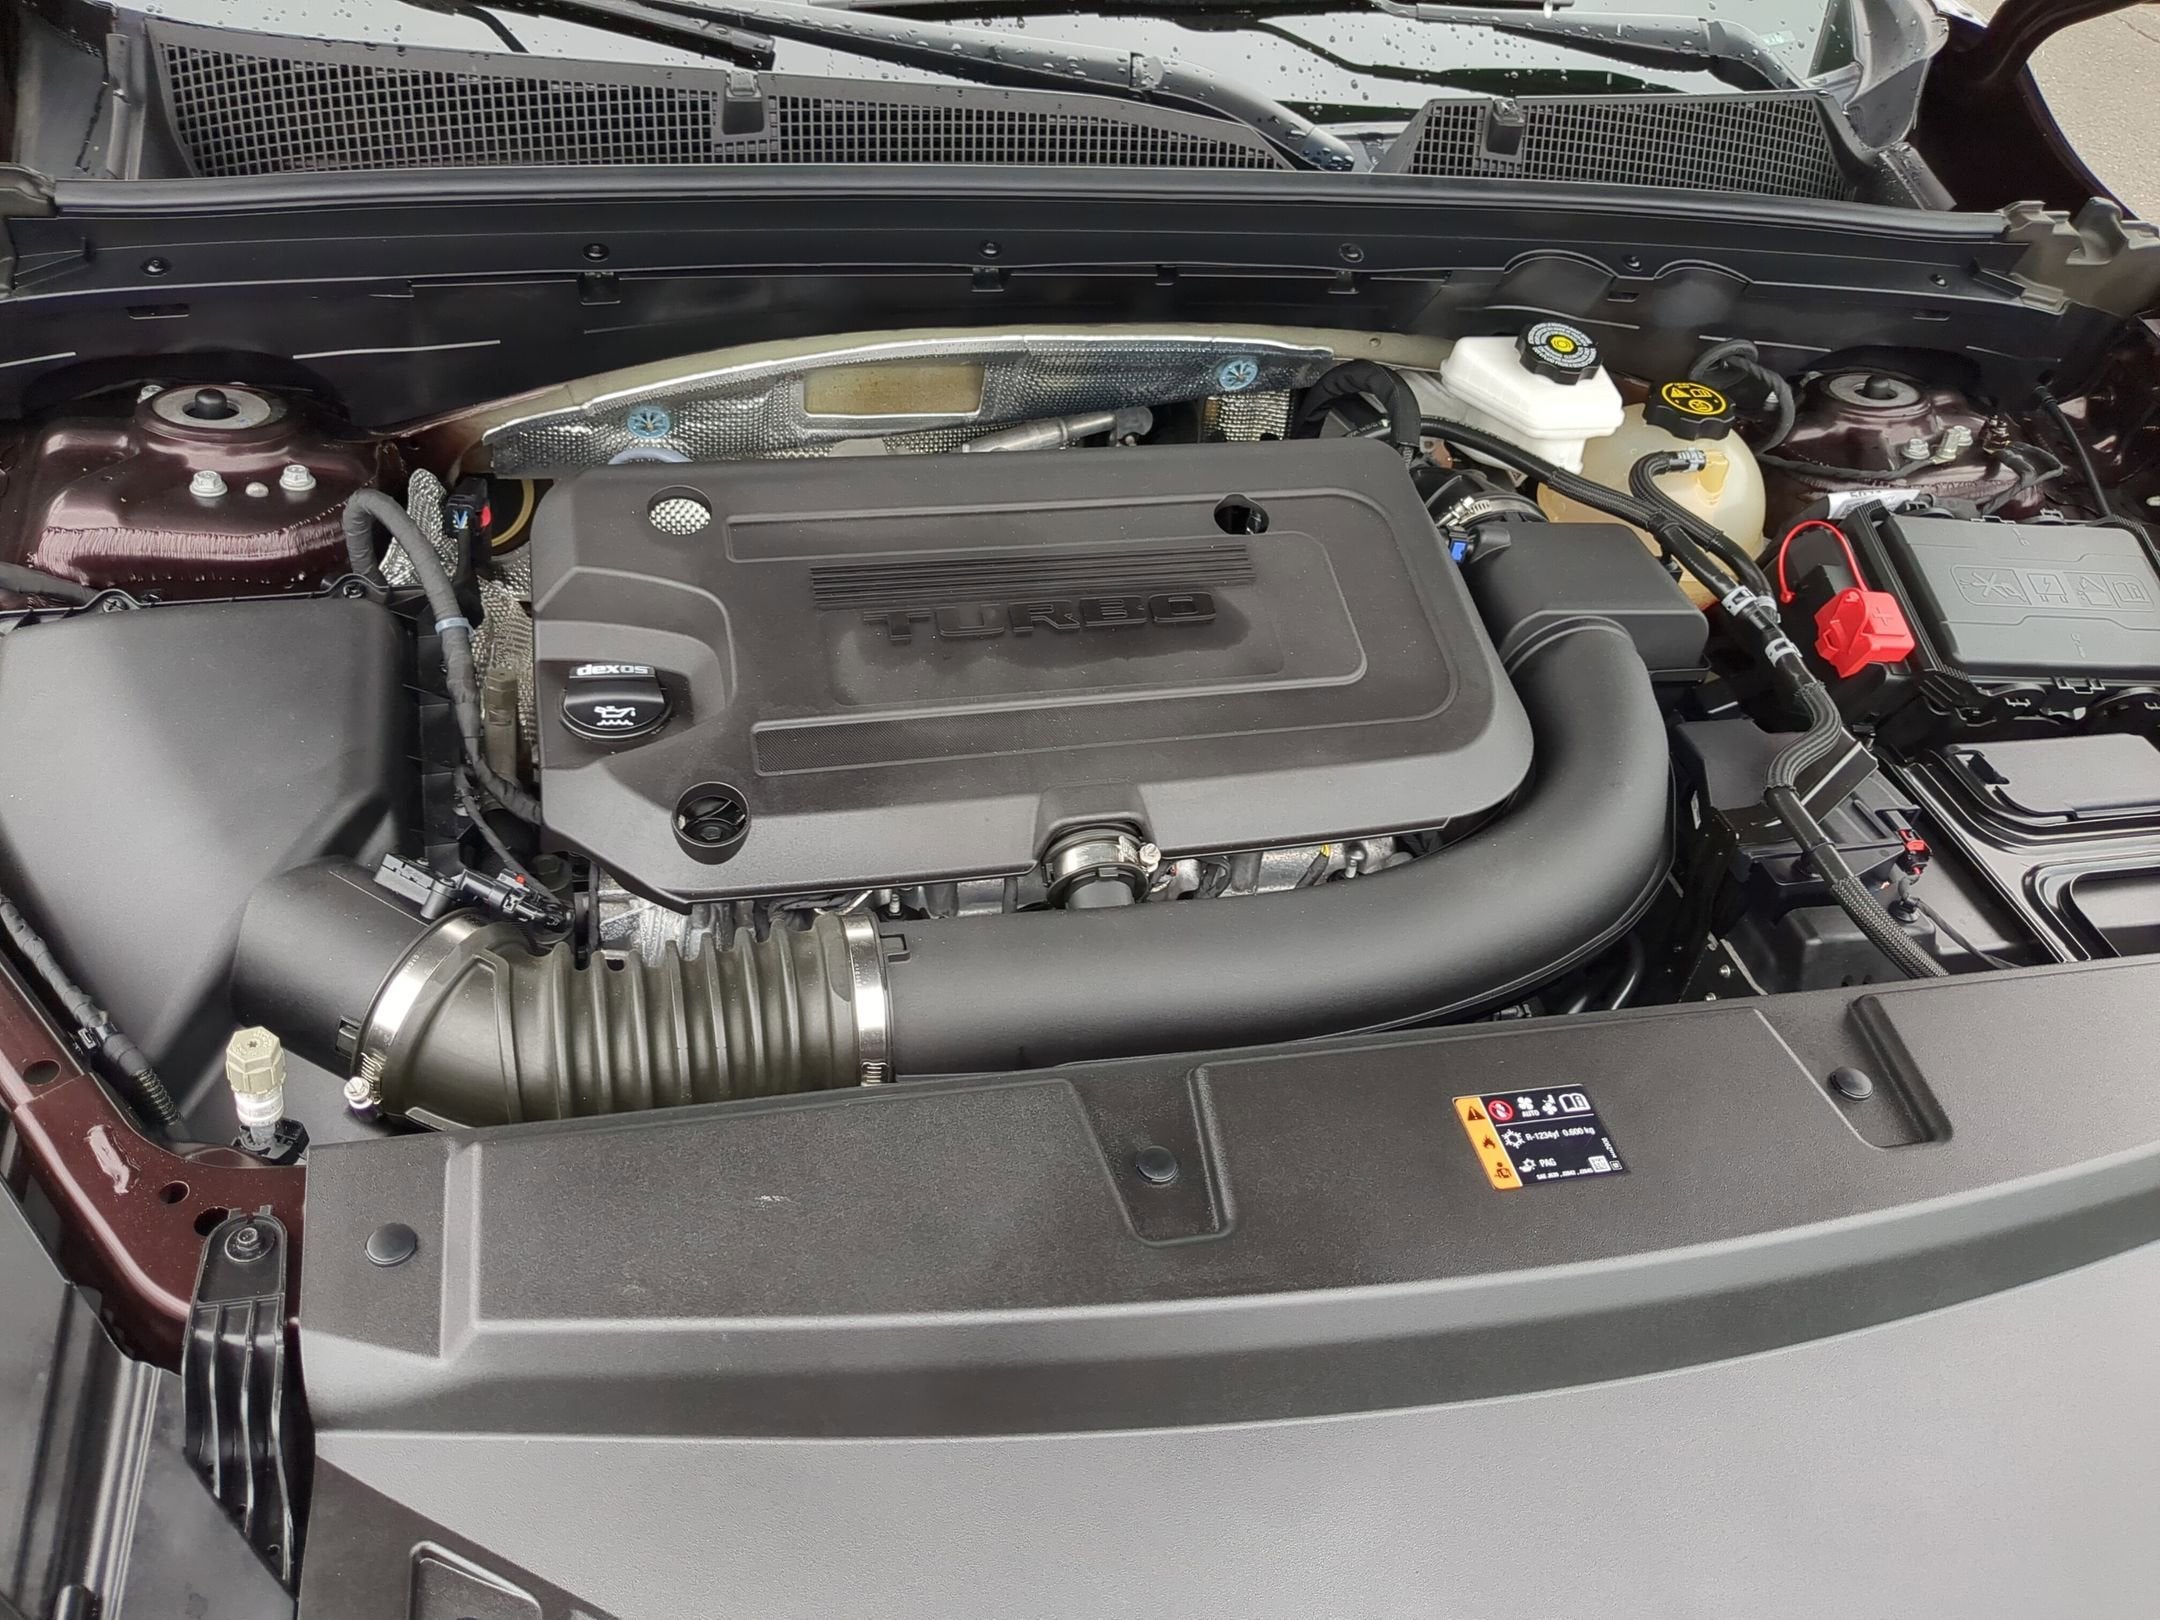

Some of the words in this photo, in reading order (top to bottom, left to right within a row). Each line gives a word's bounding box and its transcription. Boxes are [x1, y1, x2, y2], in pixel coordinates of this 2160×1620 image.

[864, 592, 1217, 645] TURBO
[576, 664, 650, 676] dexos
[1522, 1109, 1540, 1118] AUTO
[1584, 1126, 1596, 1136] kg
[1539, 1158, 1557, 1168] PAG
